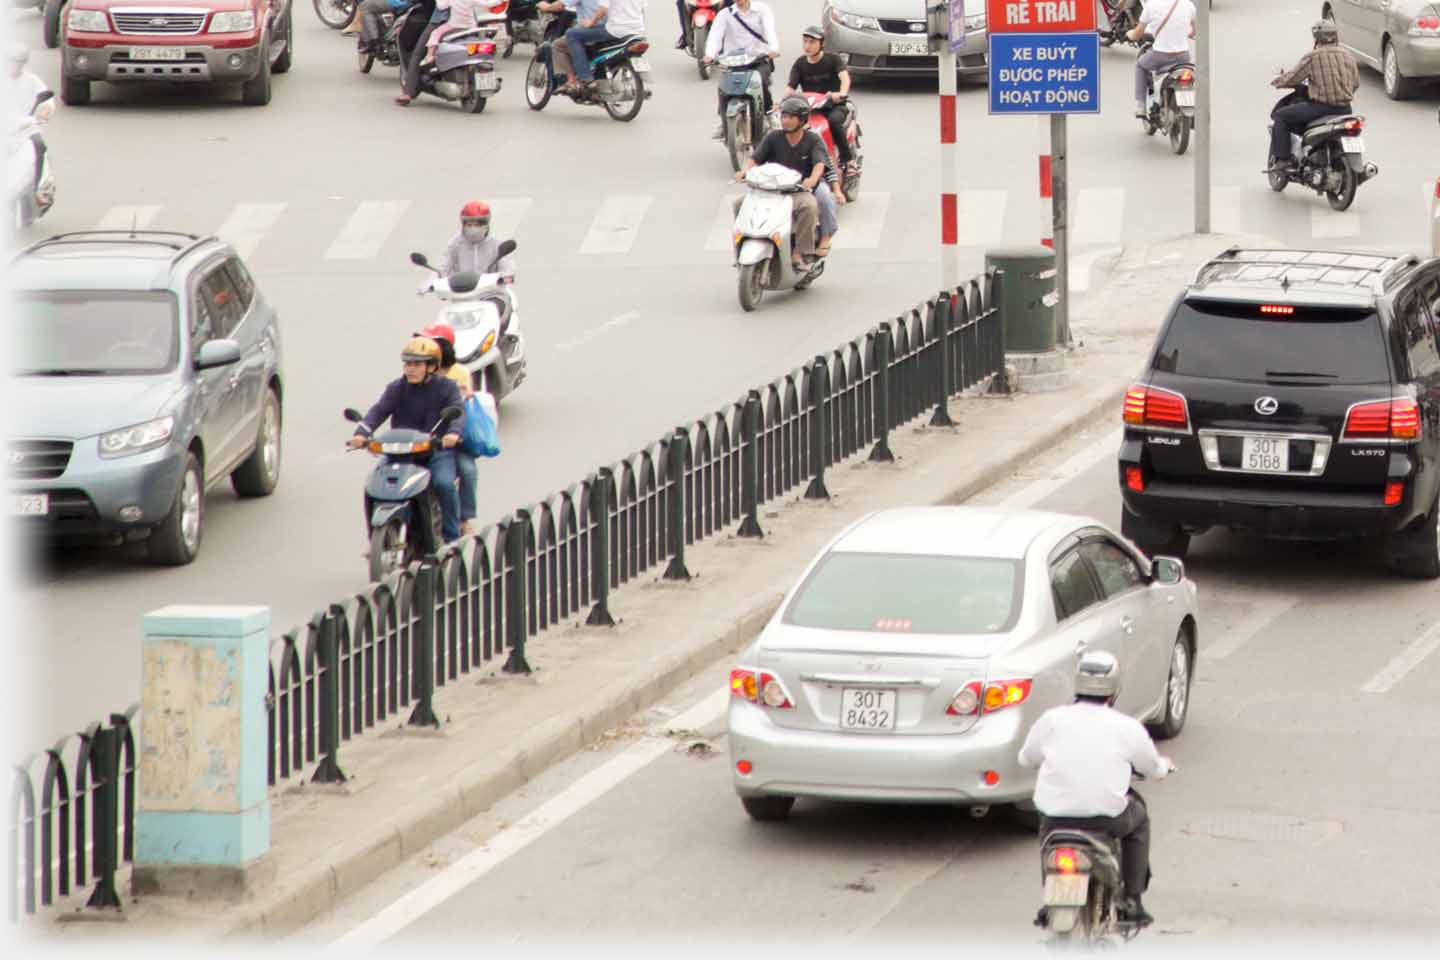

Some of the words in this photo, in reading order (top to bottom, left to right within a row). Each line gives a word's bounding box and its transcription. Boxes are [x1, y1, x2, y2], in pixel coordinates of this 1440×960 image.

[1006, 0, 1030, 24] RẼ
[1012, 47, 1032, 61] XE
[1036, 42, 1077, 61] BUÝT
[1048, 65, 1087, 82] PHÉP
[1000, 91, 1041, 107] HOẠT
[1046, 86, 1090, 107] ĐỘNG
[1148, 436, 1181, 445] LEXUS
[1253, 439, 1277, 453] 30T
[1248, 454, 1280, 469] 5168
[854, 692, 884, 708] 30T
[848, 709, 889, 727] 8432
